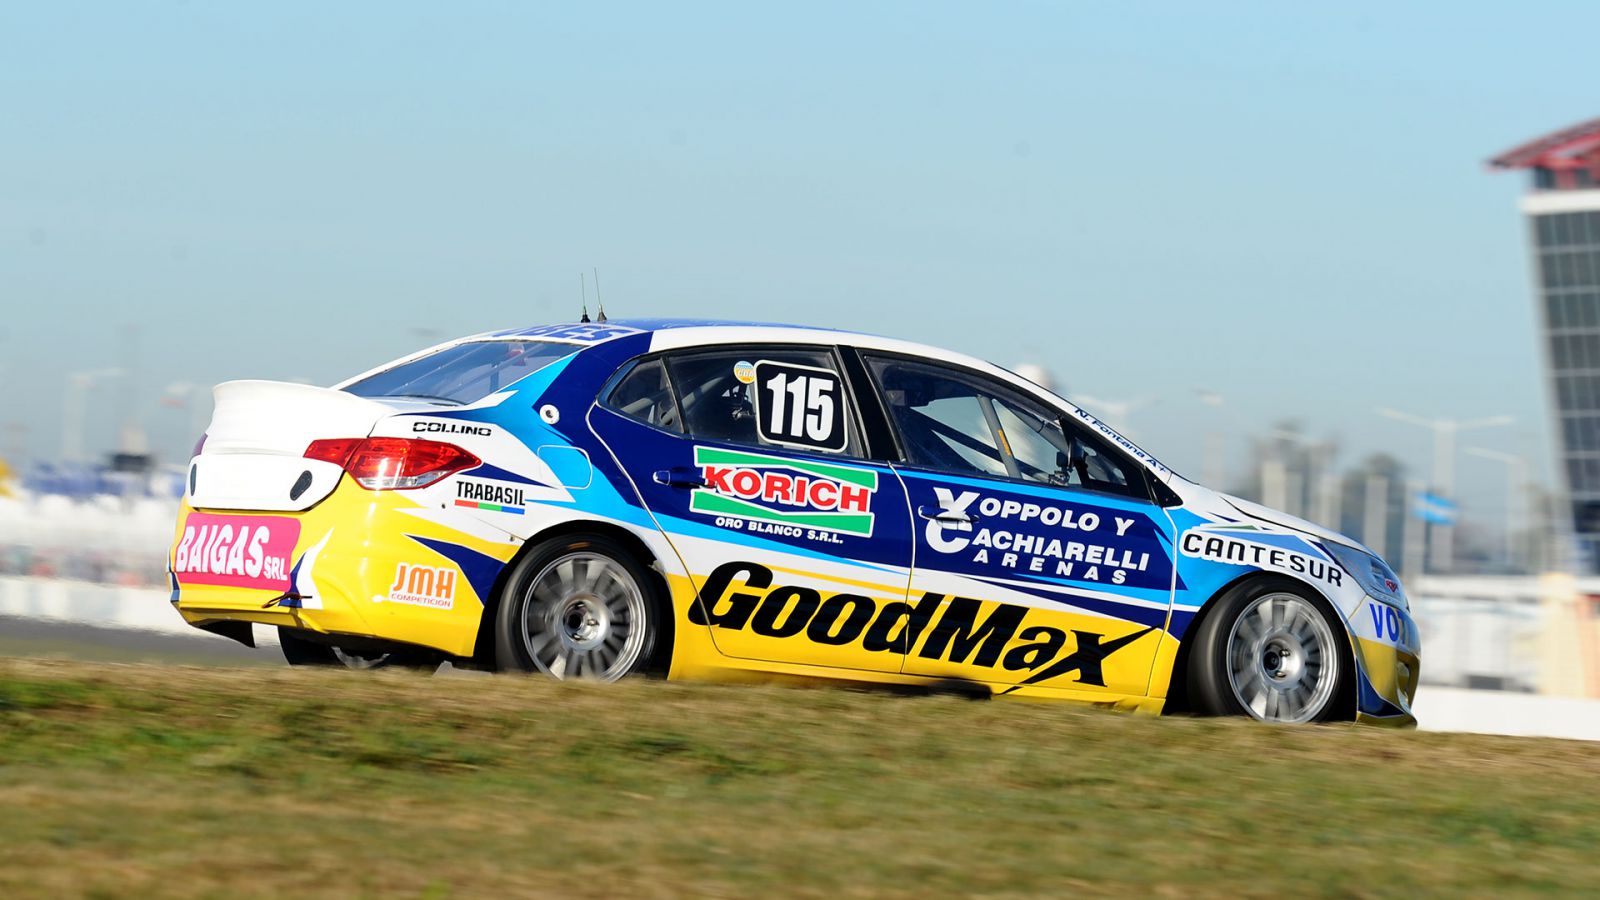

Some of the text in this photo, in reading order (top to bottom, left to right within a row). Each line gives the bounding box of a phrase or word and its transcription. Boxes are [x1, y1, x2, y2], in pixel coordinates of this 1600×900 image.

[766, 373, 834, 441] 115
[412, 421, 492, 437] COLLINO
[1092, 420, 1146, 458] Fontana
[456, 481, 525, 506] TRABASIL
[705, 466, 869, 513] KORICH
[715, 516, 844, 544] ORO BLANCO S.R.L.
[1114, 517, 1135, 537] Y
[175, 524, 288, 581] BAIGAS SRL
[1183, 533, 1343, 588] CANTESUR
[391, 593, 451, 607] COMPETICION
[392, 565, 454, 599] JMH
[687, 561, 1159, 696] GoodMax
